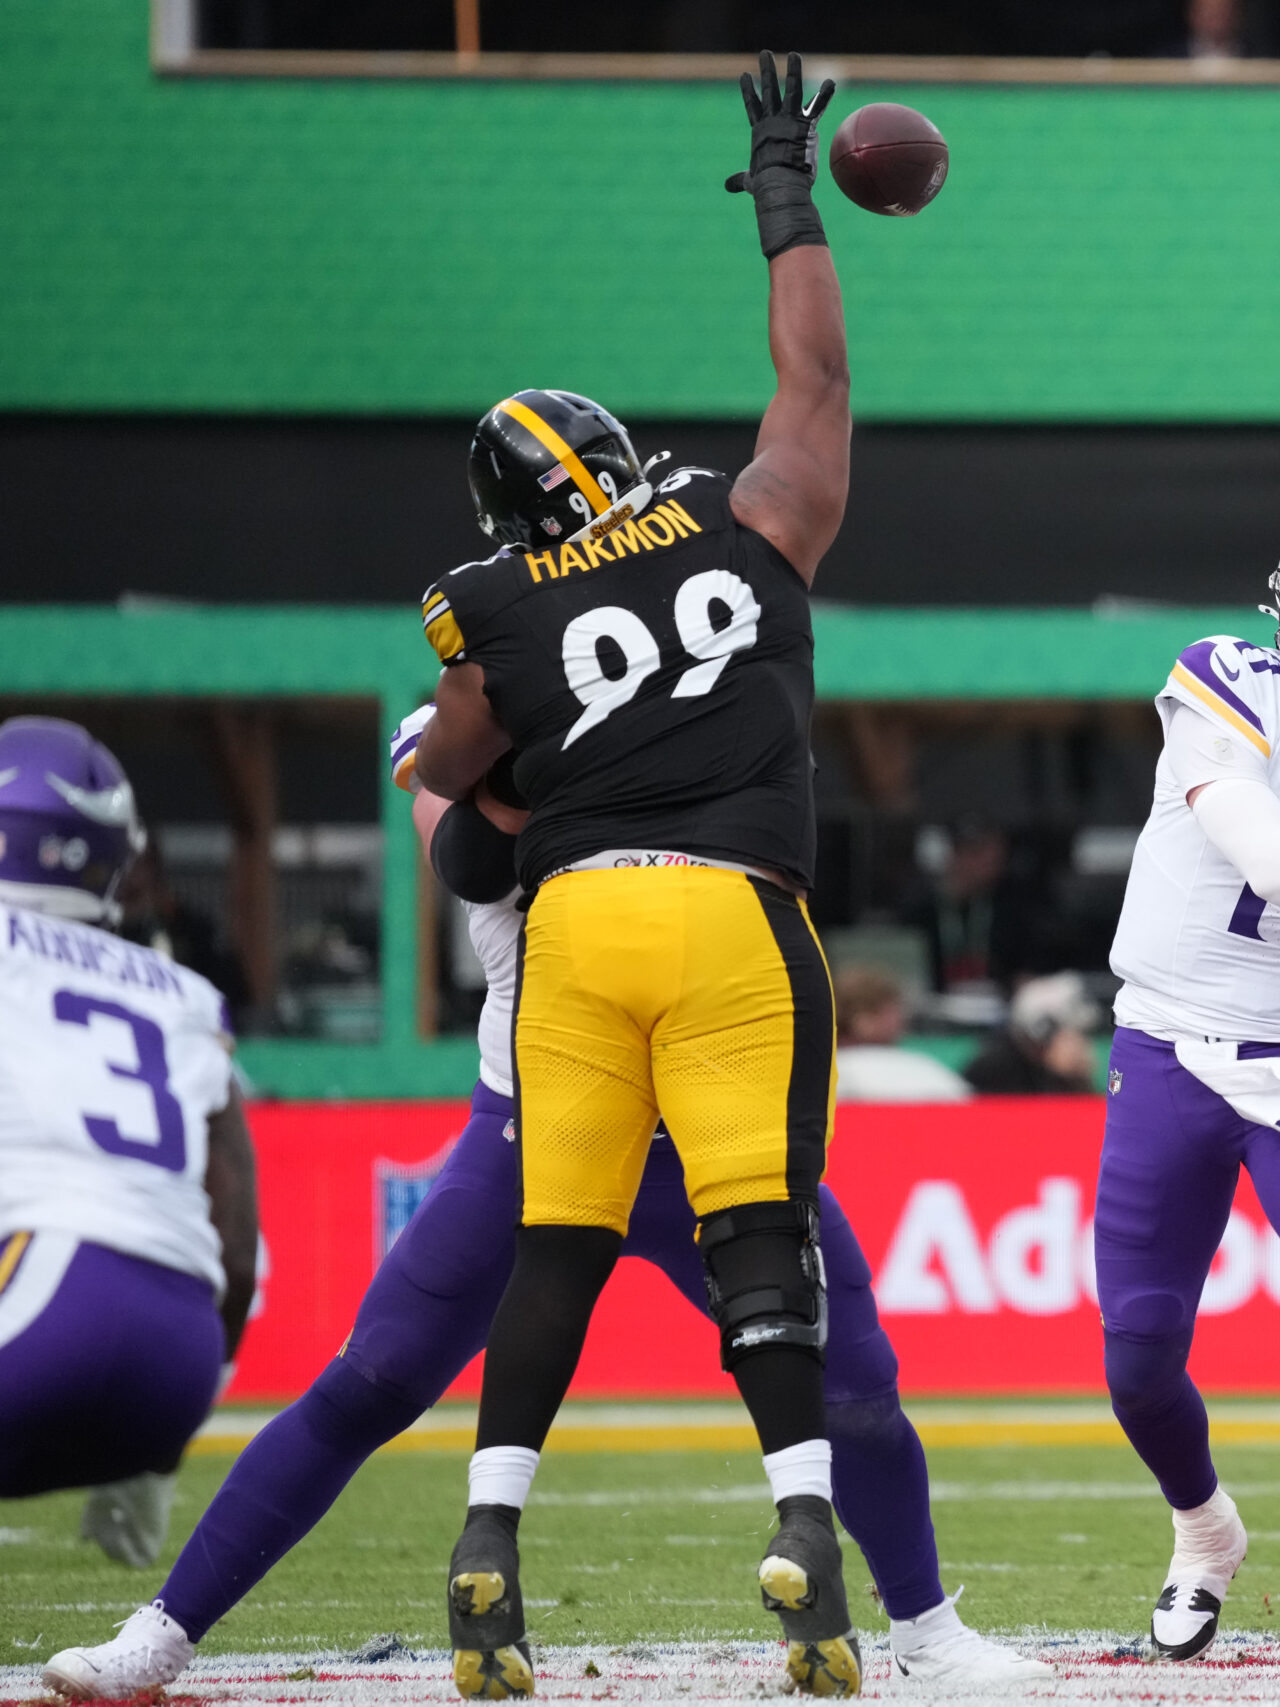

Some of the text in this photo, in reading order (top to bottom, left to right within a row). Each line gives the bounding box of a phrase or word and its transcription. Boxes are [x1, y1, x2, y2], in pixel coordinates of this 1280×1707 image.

[525, 499, 703, 583] HARMON
[590, 503, 634, 540] Steelers
[560, 569, 762, 751] 99
[54, 990, 187, 1172] 3
